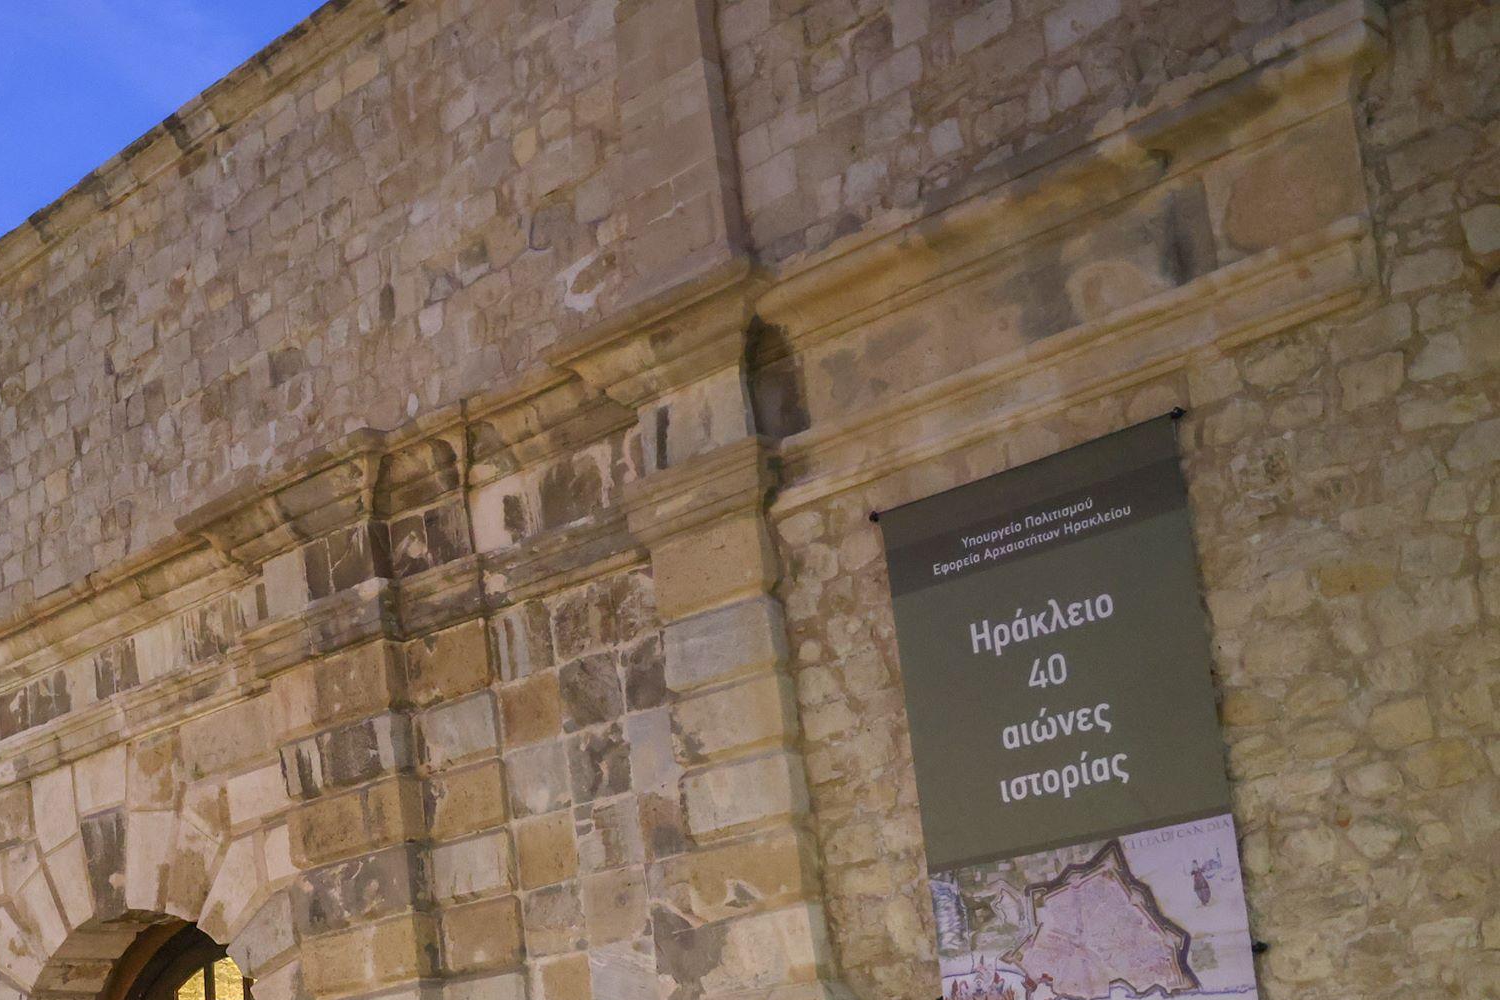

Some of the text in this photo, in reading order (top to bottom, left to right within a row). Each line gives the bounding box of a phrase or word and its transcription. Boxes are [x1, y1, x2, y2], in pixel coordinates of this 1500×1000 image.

[933, 505, 1131, 576] Εφορεία Αρχαιοτήτων Ηρακλείου
[961, 496, 1093, 548] Υπουργείο Πολιτισμού
[970, 594, 1114, 655] Ηράκλειο
[1028, 653, 1067, 688] 40
[1002, 702, 1111, 750] αιώνες
[1000, 752, 1129, 803] ιστορίας
